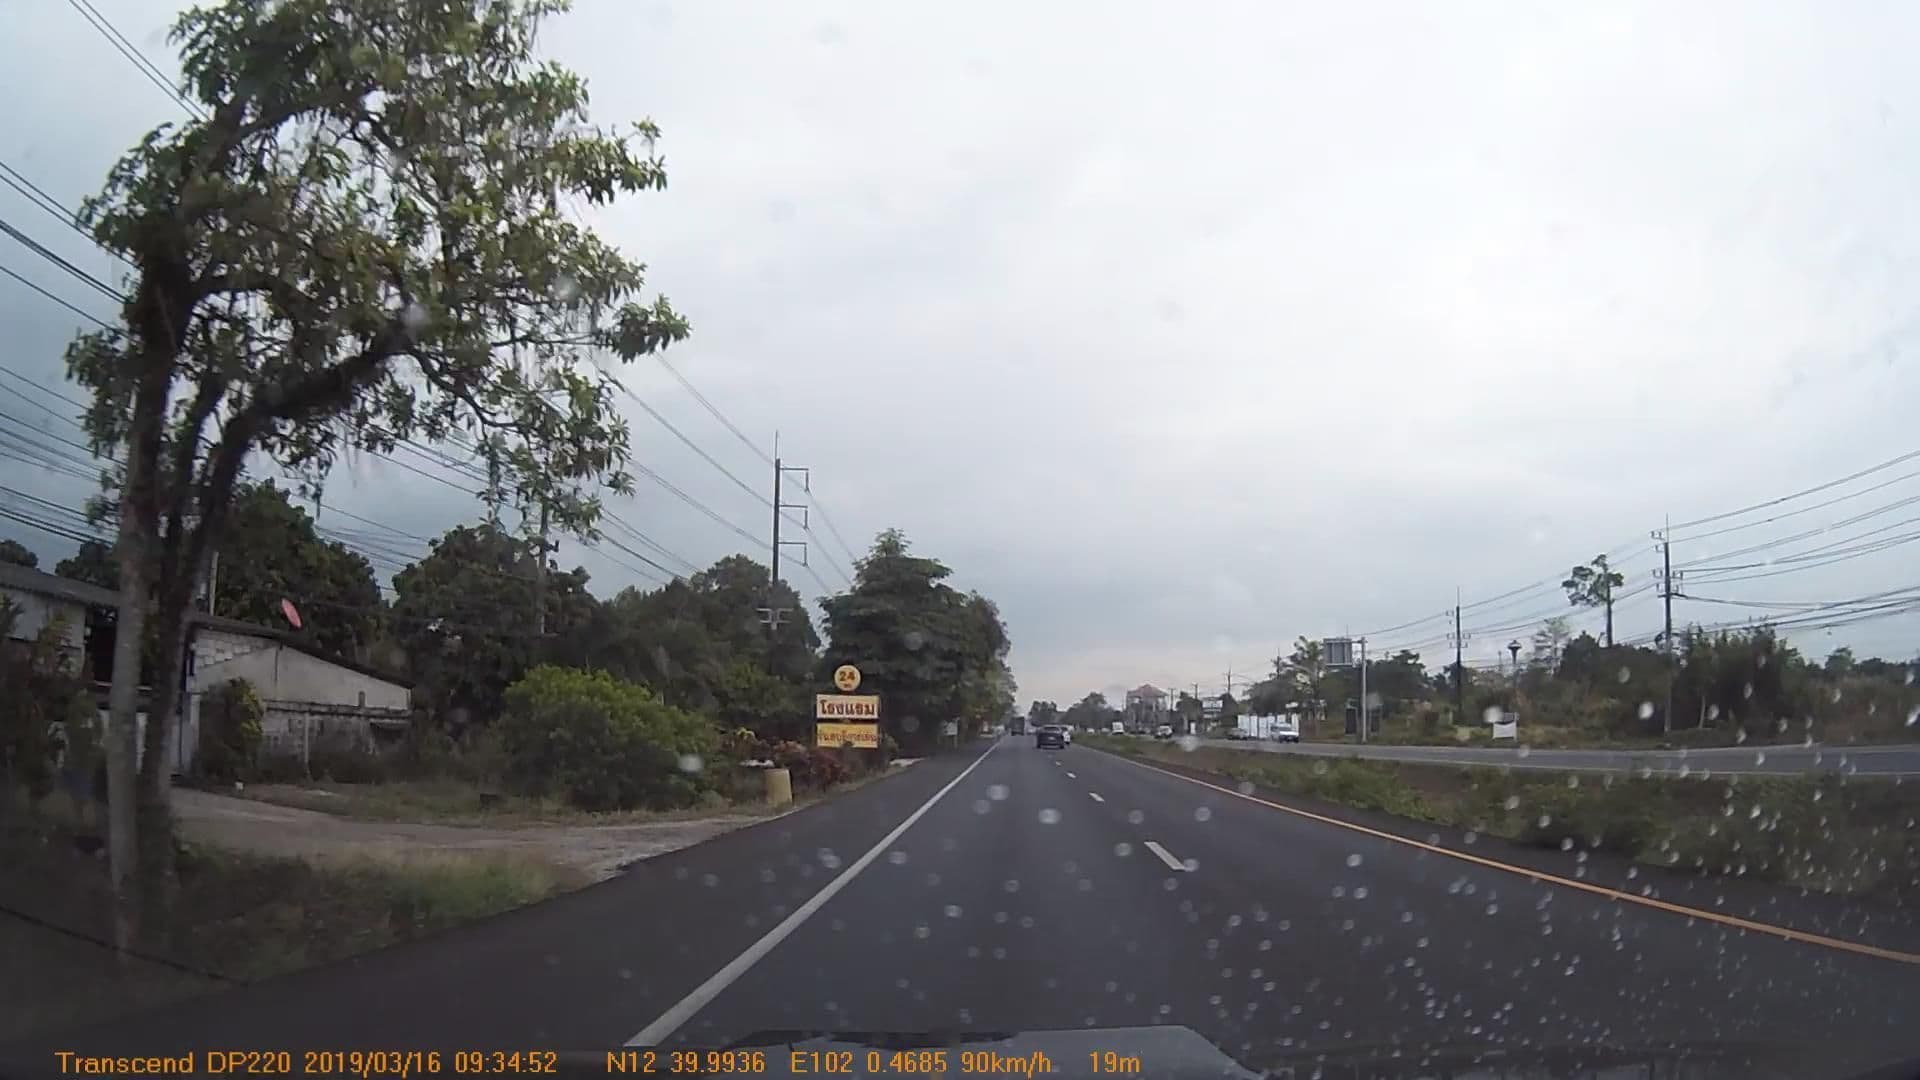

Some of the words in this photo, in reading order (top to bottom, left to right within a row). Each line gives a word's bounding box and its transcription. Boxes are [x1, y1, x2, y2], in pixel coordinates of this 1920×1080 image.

[839, 671, 856, 682] 24
[820, 699, 875, 715] โรงแรม
